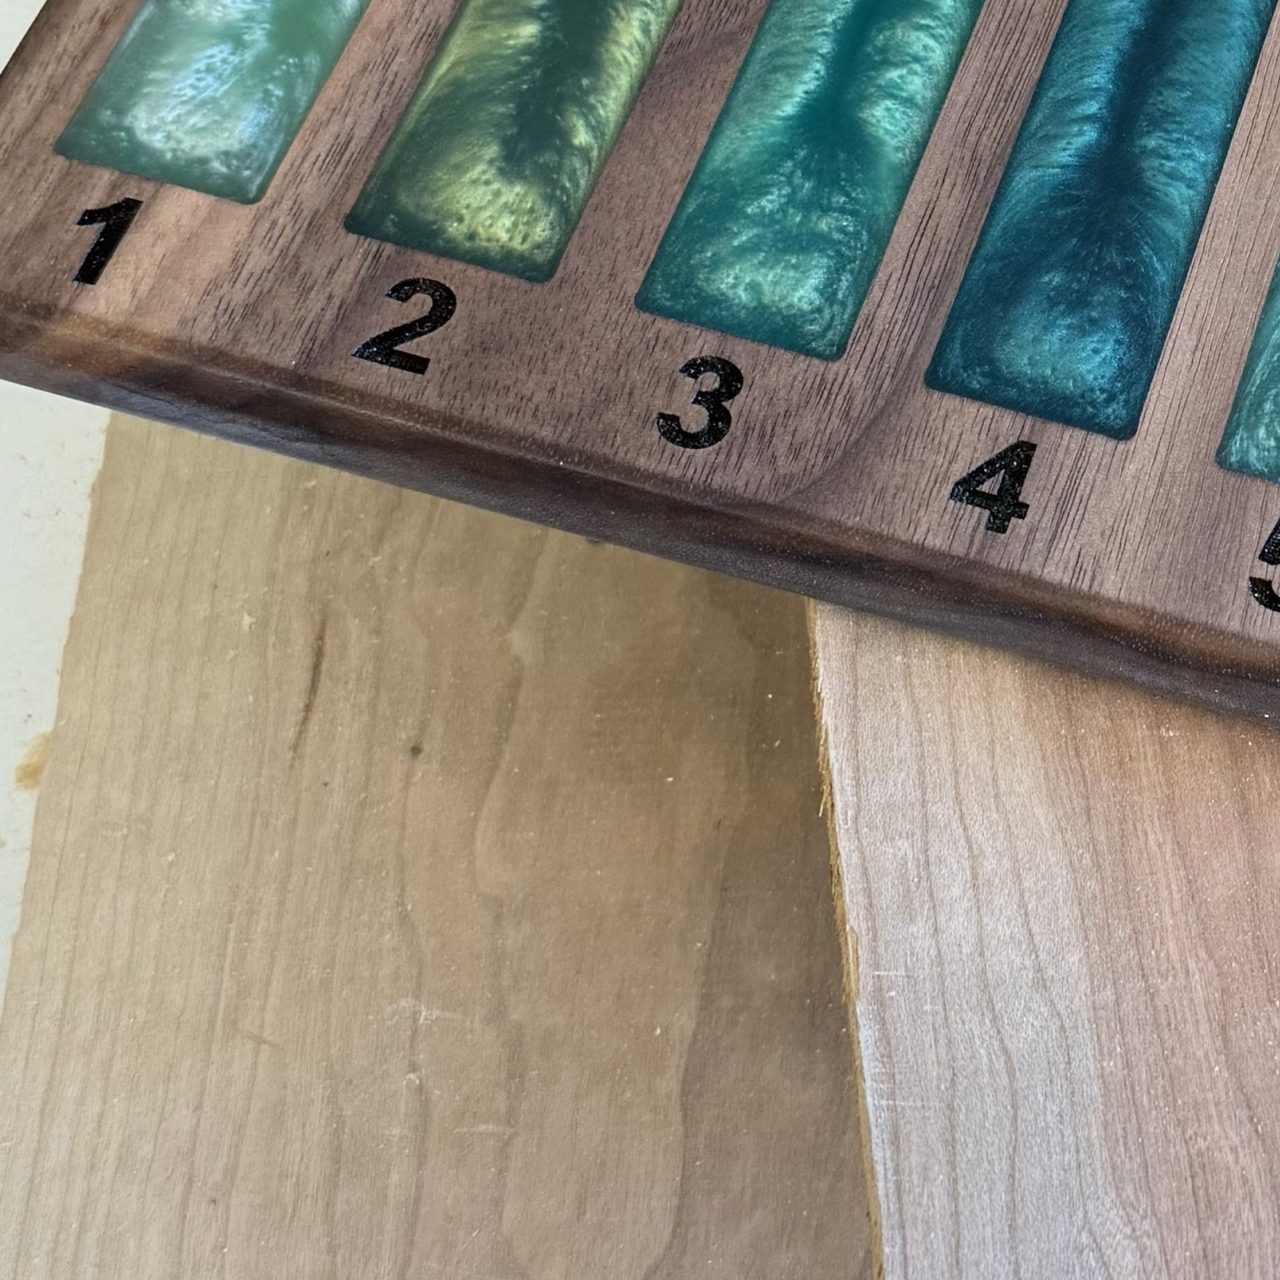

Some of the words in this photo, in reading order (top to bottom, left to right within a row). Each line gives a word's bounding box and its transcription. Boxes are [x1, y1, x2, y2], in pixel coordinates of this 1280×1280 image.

[73, 198, 143, 286] 1
[352, 277, 457, 375] 2
[655, 356, 744, 449] 3
[949, 440, 1037, 534] 4
